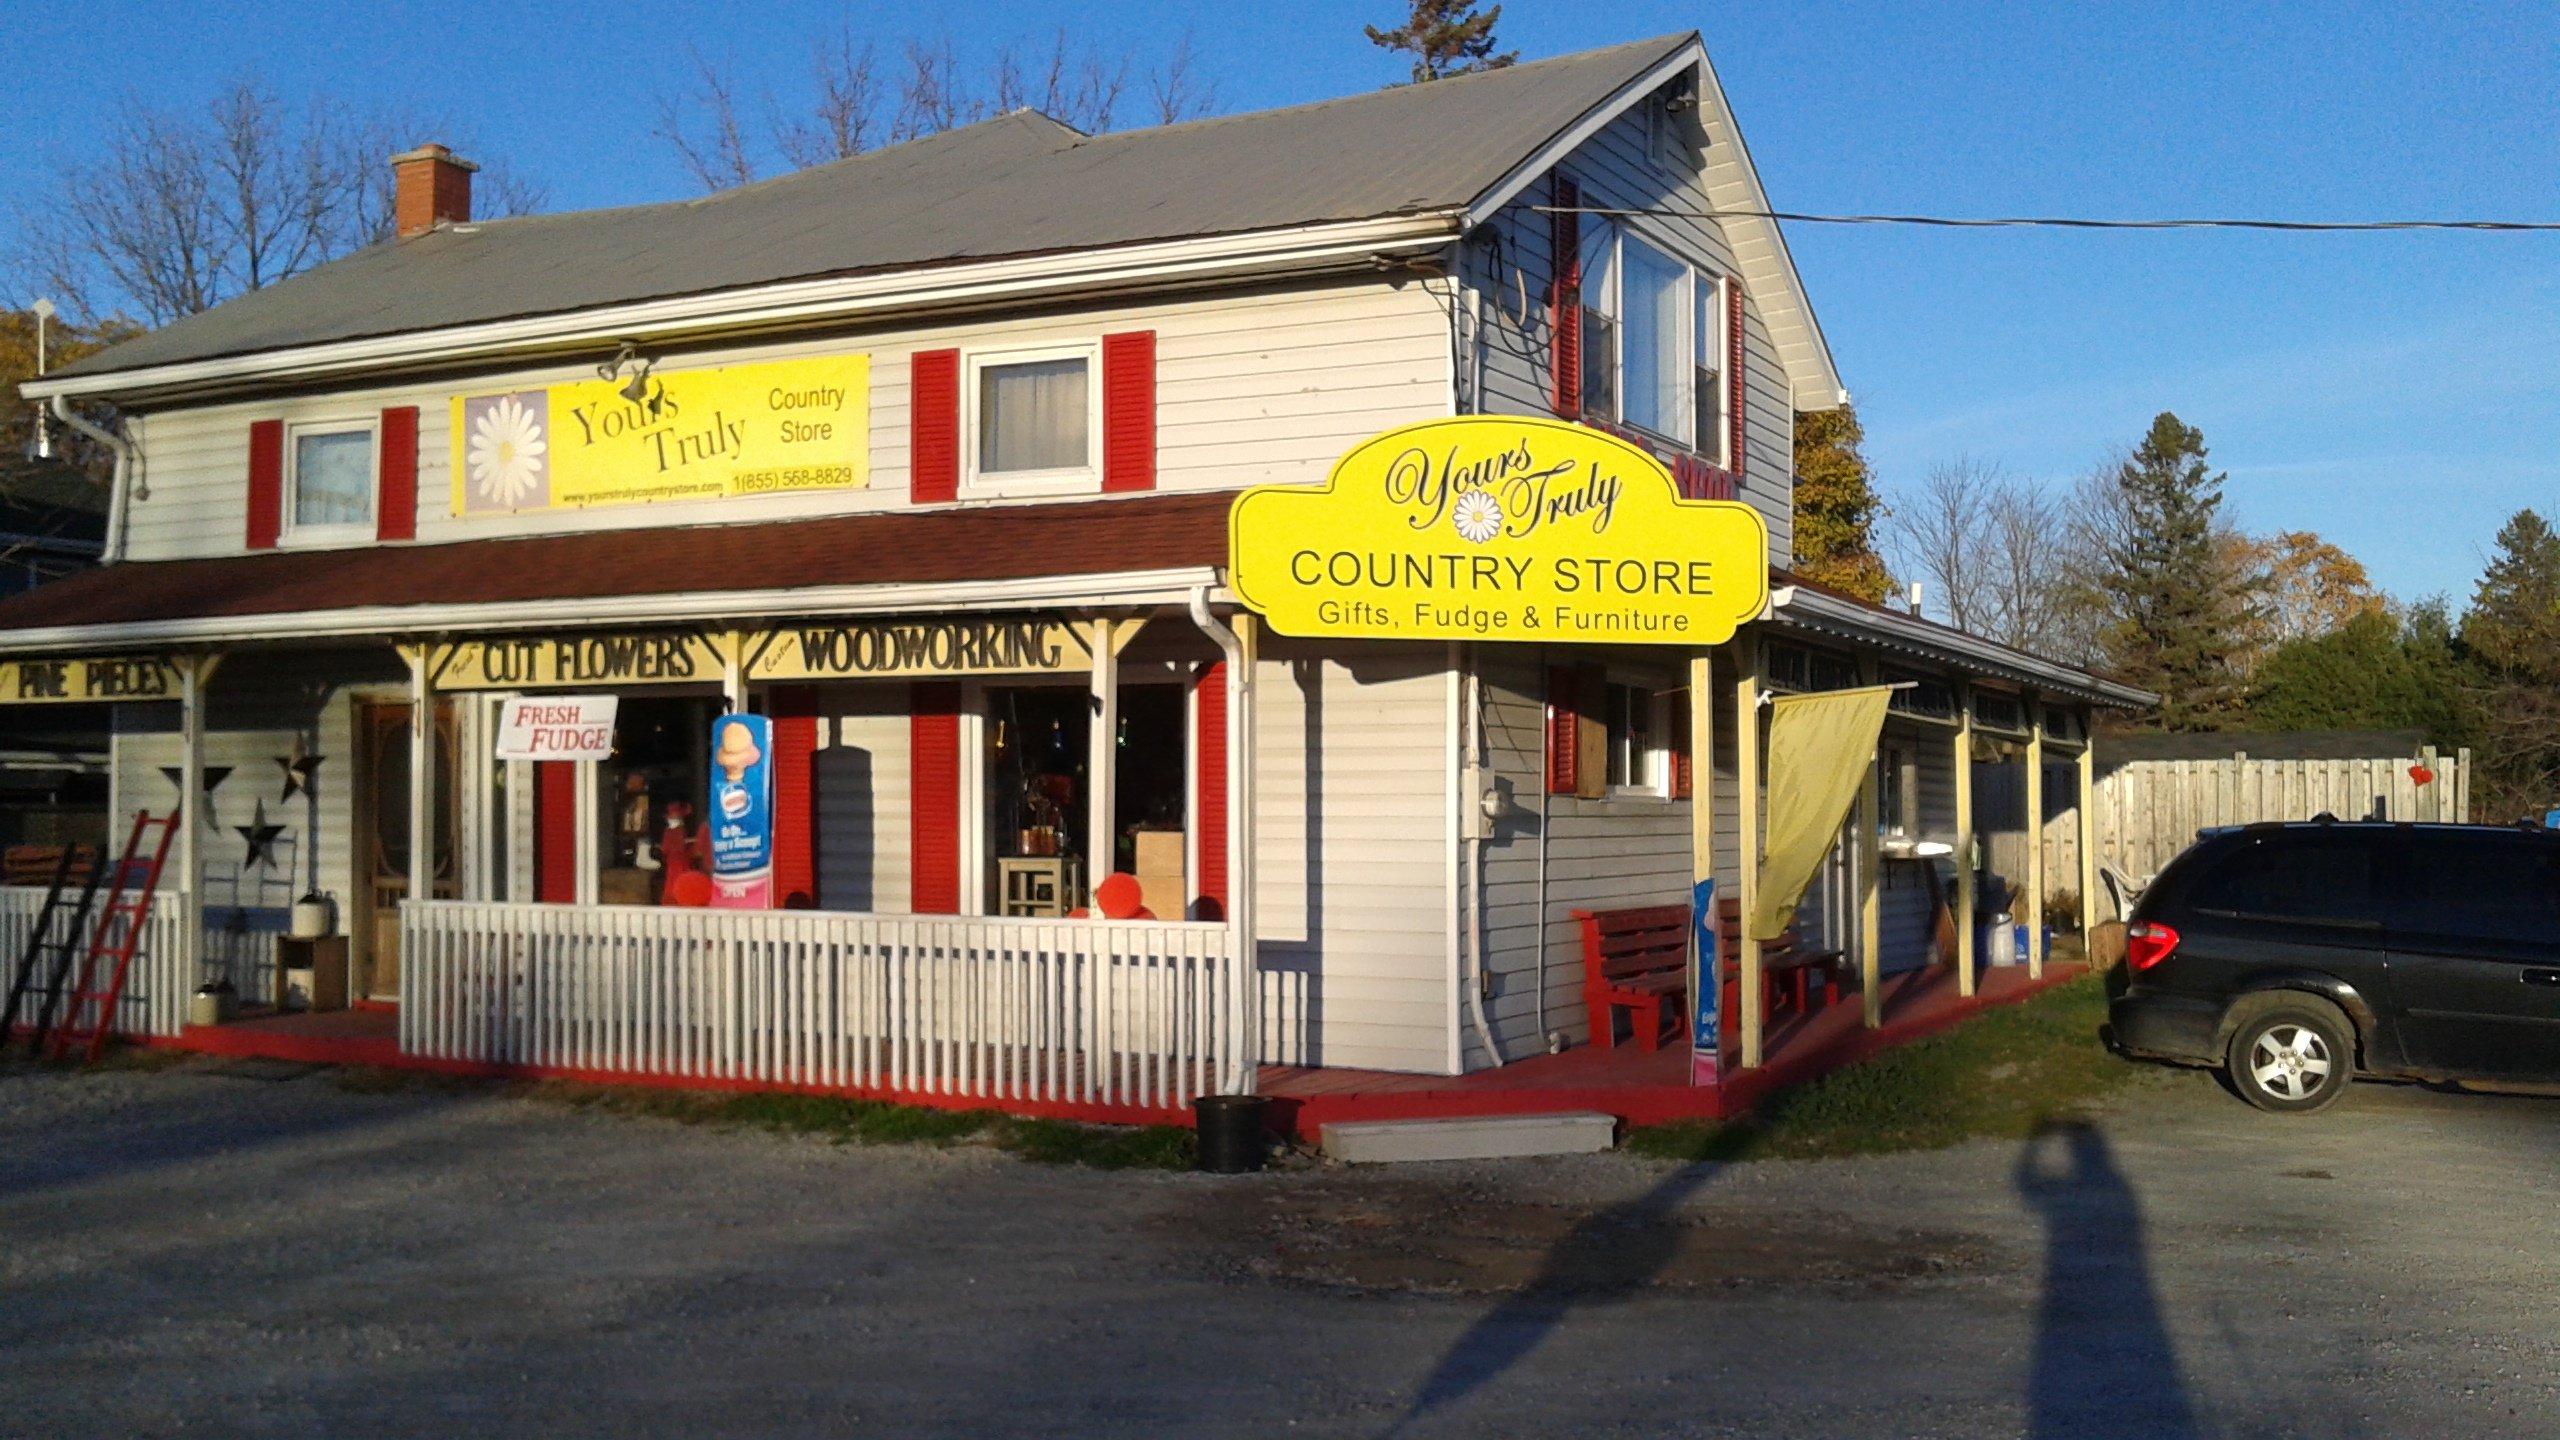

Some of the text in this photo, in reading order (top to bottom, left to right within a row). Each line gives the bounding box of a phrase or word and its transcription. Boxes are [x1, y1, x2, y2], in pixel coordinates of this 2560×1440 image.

[571, 388, 680, 447] Yours
[768, 384, 846, 412] Country
[643, 410, 746, 472] Truly
[780, 419, 834, 443] Store
[733, 466, 853, 491] 1(855) 568-8829
[1385, 437, 1532, 530] Yours
[1501, 459, 1623, 539] Truly
[1290, 550, 1714, 595] COUNTRY STORE
[1317, 600, 1690, 632] Gifts, Fudge & Furniture
[483, 639, 543, 682] CUT
[555, 634, 695, 680] FLOWERS
[800, 620, 1062, 672] WOODWORKING
[18, 659, 168, 698] PINE PIECES
[515, 704, 582, 727] FRESH
[529, 728, 608, 752] FUDGE
